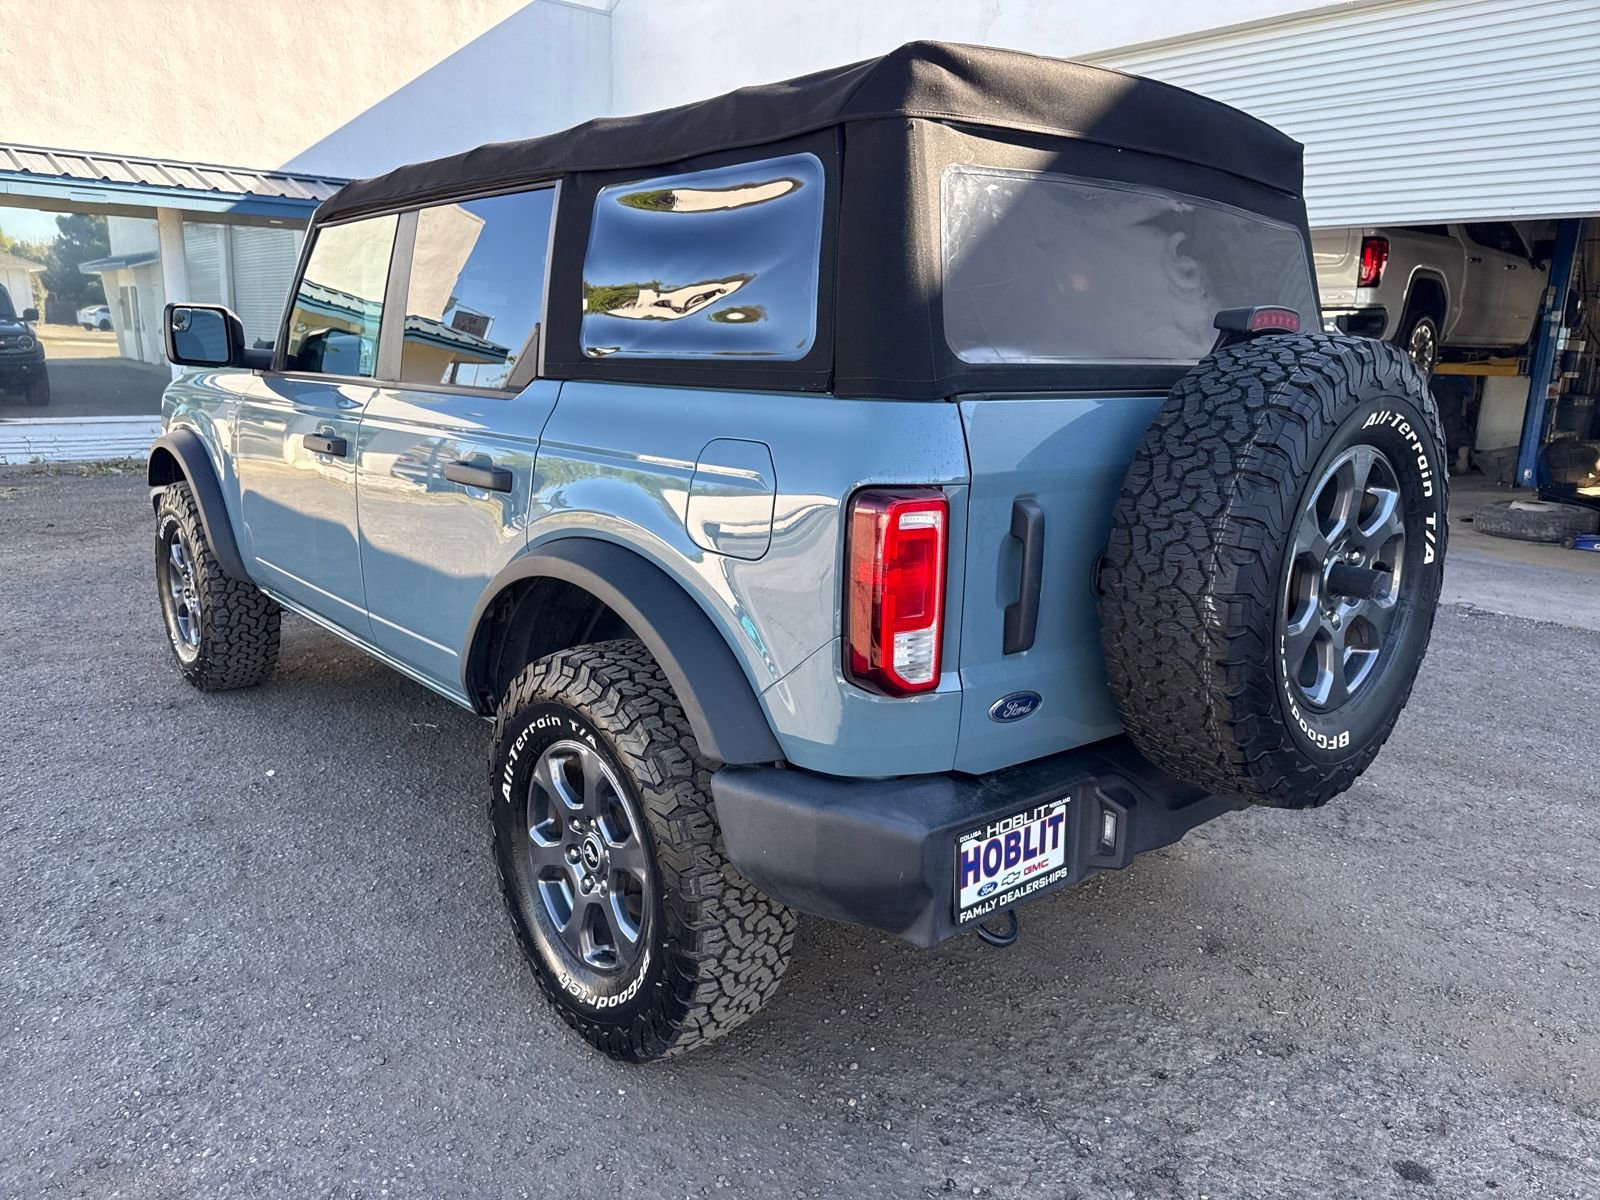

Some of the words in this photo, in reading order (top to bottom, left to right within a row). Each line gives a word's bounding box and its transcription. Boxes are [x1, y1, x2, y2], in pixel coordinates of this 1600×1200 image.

[1362, 410, 1433, 497] All-Terrain
[1423, 512, 1437, 565] T/A
[502, 714, 561, 804] All-Terrain
[568, 719, 598, 750] T/A
[960, 830, 982, 843] COLUSA
[987, 804, 1049, 838] HOBLIT
[961, 812, 1065, 890] HOBLIT
[1023, 858, 1049, 876] GMC
[959, 898, 998, 924] FAMILY
[999, 867, 1068, 906] DEALERSHIPS
[979, 883, 996, 896] Ford
[559, 948, 652, 1009] BFGoodrich
